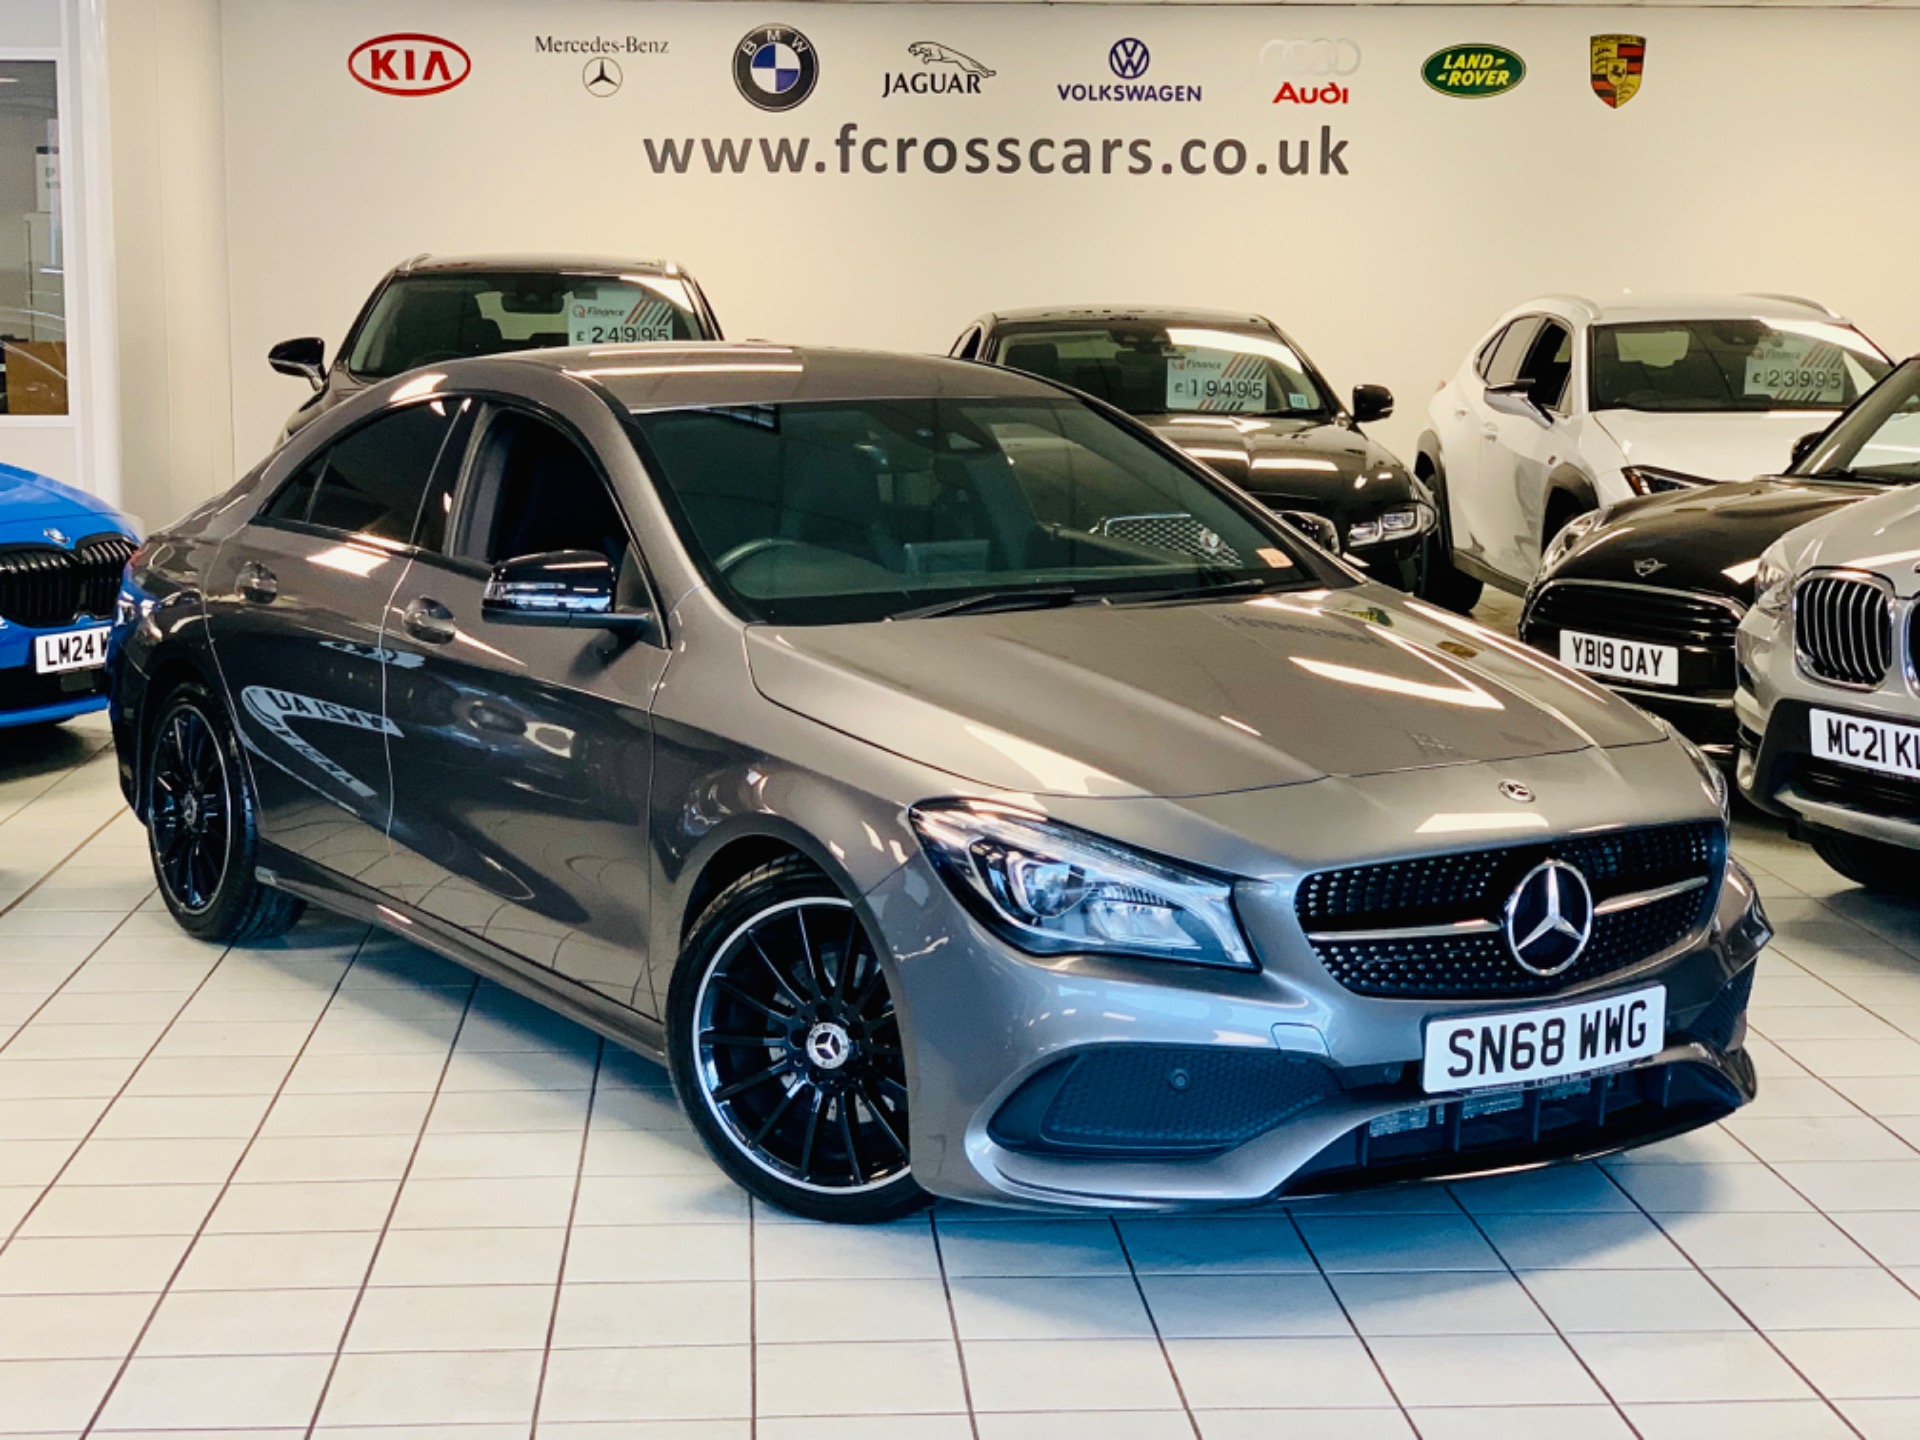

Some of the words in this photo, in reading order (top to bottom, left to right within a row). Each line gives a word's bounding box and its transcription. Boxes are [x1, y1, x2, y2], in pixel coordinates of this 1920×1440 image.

[535, 35, 669, 54] Mercedes-Benz
[370, 48, 453, 81] KIA
[882, 72, 982, 98] JAGUAR
[1057, 83, 1202, 102] VOLKSWAGEN
[1273, 82, 1348, 104] Audi
[643, 122, 1349, 175] www.fcrosscars.co.uk
[45, 634, 94, 666] LM24
[1573, 636, 1614, 669] YB19
[1620, 645, 1663, 677] OAY
[1827, 718, 1886, 764] MC21
[1447, 1018, 1566, 1078] SN68
[1579, 1000, 1646, 1060] WWG
